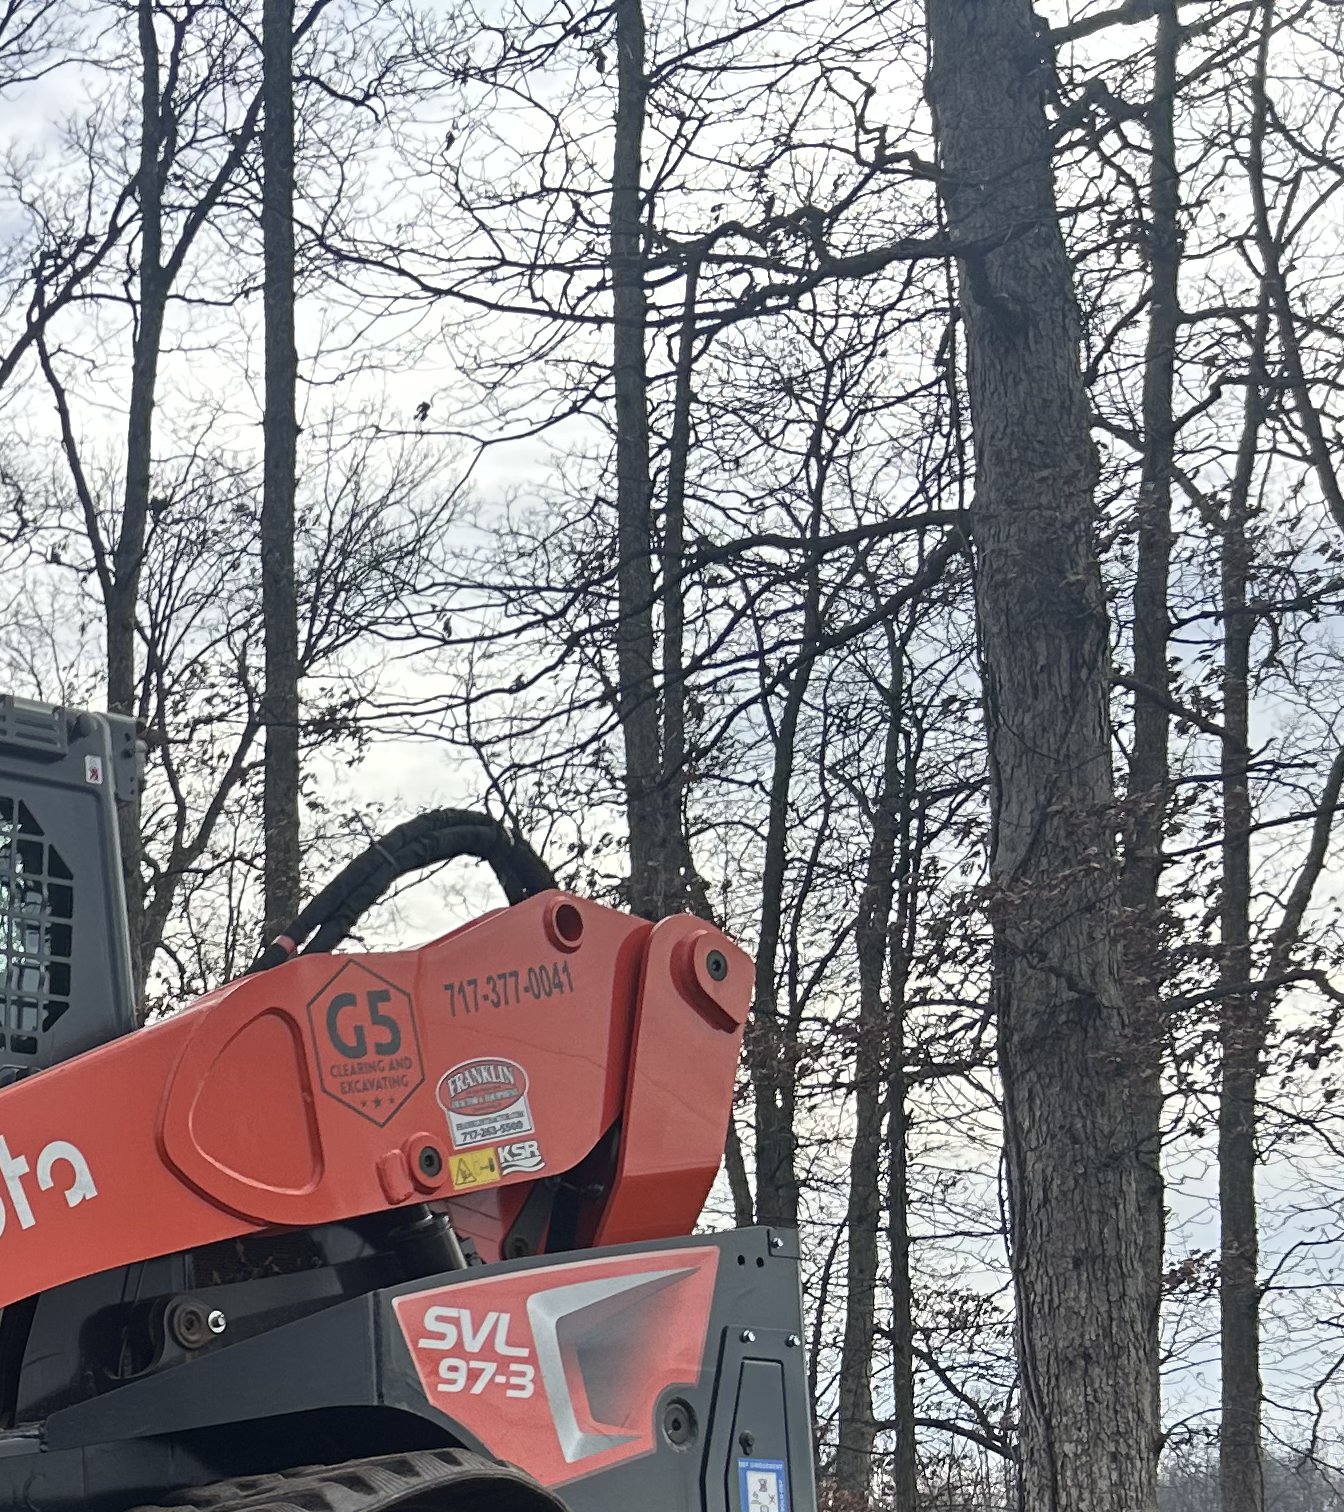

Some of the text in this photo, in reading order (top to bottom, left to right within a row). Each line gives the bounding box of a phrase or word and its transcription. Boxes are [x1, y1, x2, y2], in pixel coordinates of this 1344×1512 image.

[443, 960, 574, 1017] 717-377-0041
[326, 990, 401, 1059] G5
[330, 1057, 412, 1078] CLEARING AND
[340, 1075, 409, 1095] EXCAVATING
[447, 1064, 515, 1098] FRANKLIN
[497, 1140, 541, 1164] KSR
[417, 1305, 530, 1357] SVL
[437, 1357, 535, 1398] 97-3
